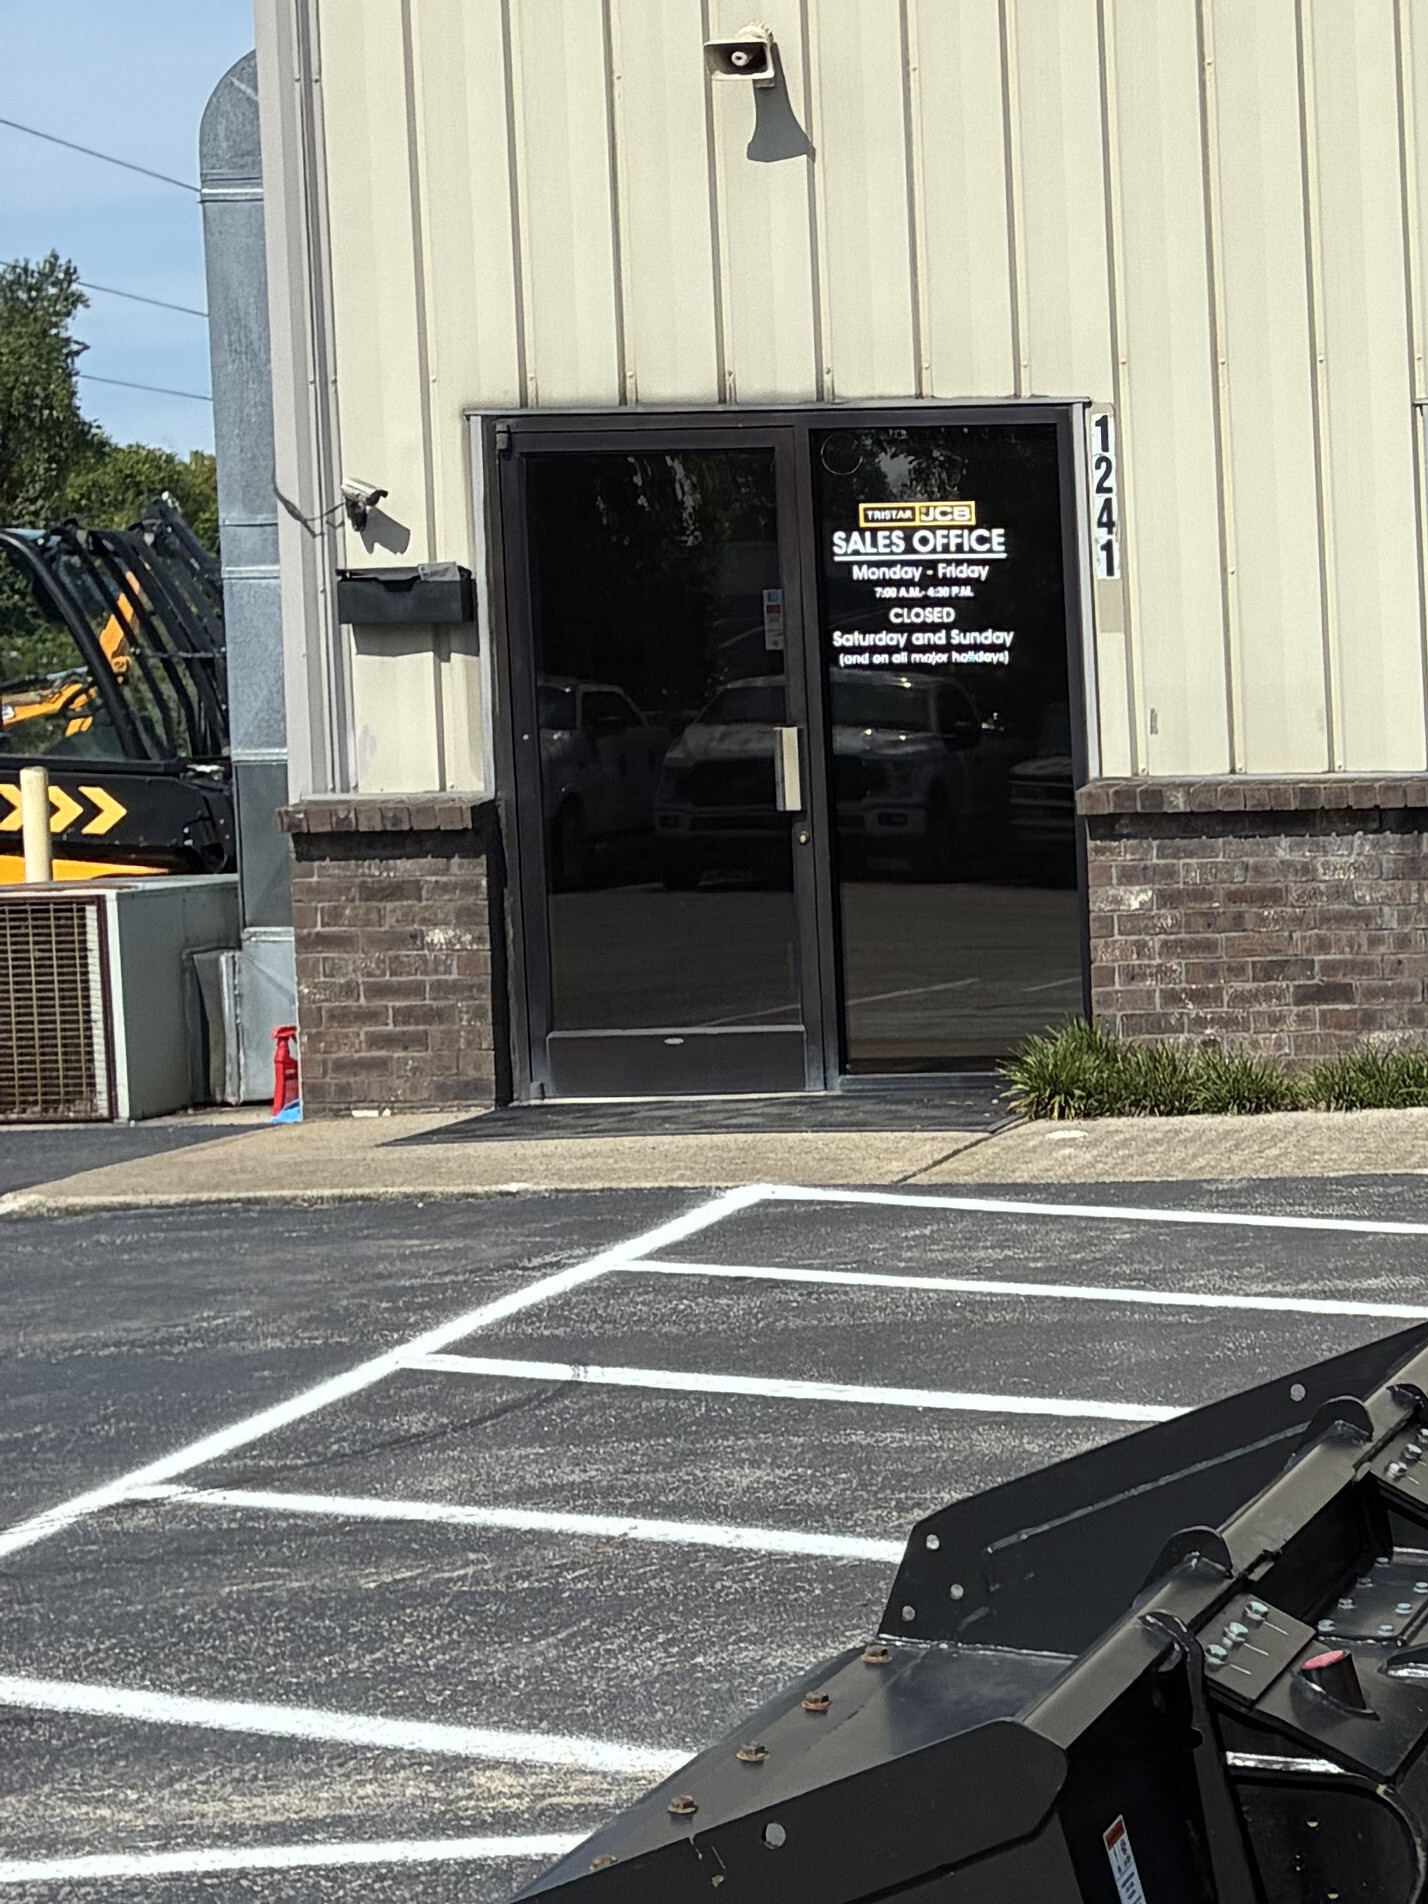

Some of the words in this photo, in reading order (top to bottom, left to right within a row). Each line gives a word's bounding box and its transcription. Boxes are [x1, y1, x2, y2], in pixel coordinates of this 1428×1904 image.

[1095, 415, 1115, 577] 1241
[866, 509, 913, 520] TRISTAR
[920, 506, 970, 521] JCB
[832, 530, 906, 554] SALES
[912, 528, 1006, 552] OFFICE
[852, 564, 922, 582] Monday
[937, 563, 989, 581] Friday
[889, 607, 956, 623] CLOSED
[832, 630, 908, 648] Saturday
[912, 629, 947, 645] and
[950, 628, 1014, 647] Sunday
[839, 653, 869, 667] (and
[872, 653, 889, 664] on
[892, 652, 908, 664] all
[911, 651, 949, 666] major
